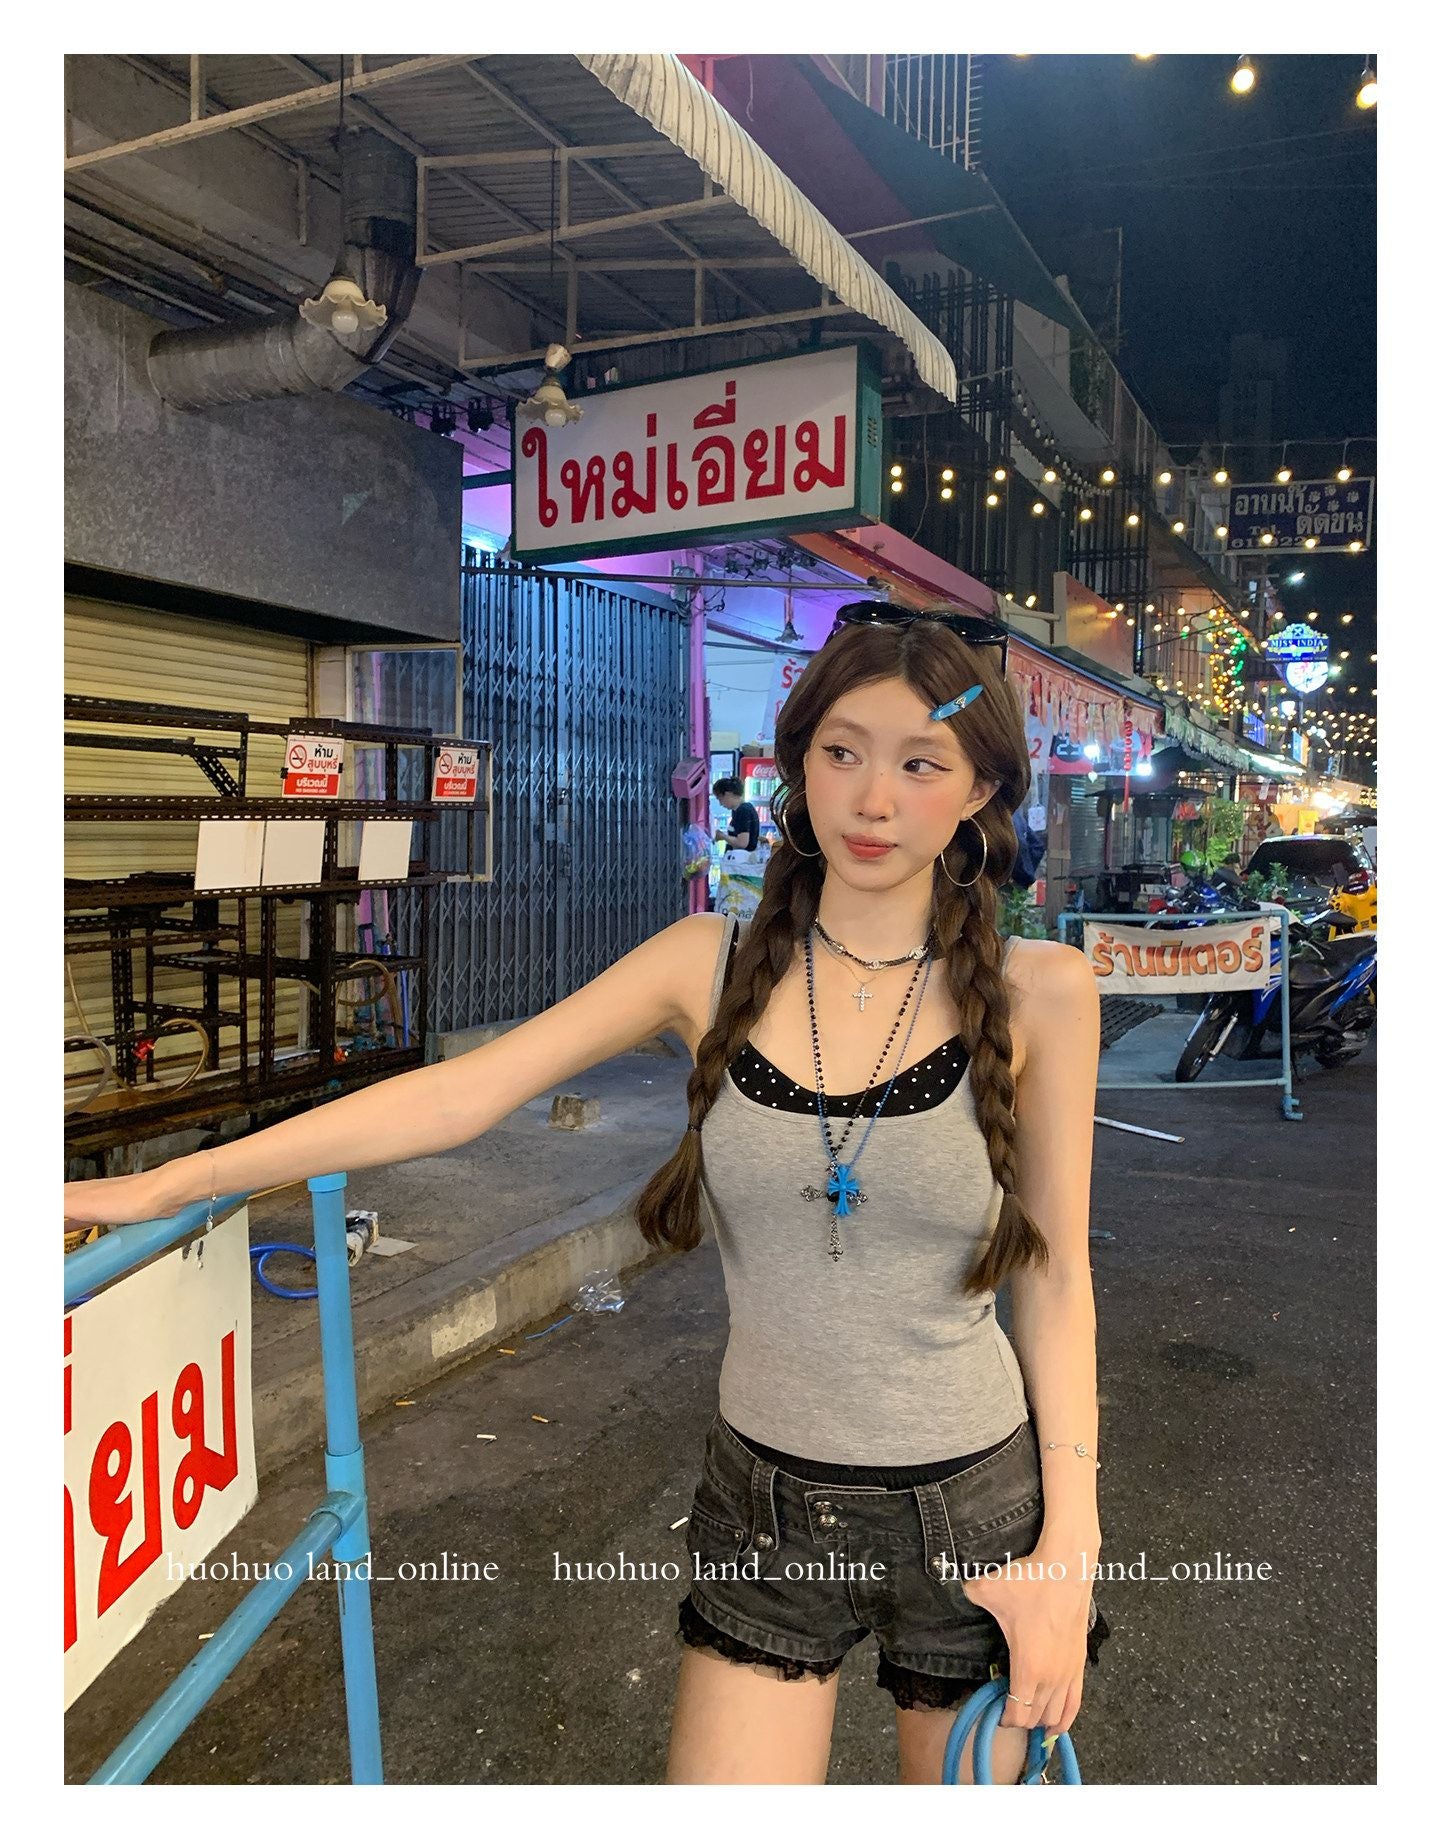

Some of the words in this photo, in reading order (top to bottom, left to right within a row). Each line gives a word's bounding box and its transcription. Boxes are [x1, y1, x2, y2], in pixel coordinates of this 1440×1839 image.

[521, 381, 846, 529] ใหม่เอี่ยม
[1234, 485, 1308, 516] อาบน้ำ
[1271, 640, 1293, 648] MISS
[1297, 640, 1324, 648] INDIA
[314, 744, 334, 758] ห้าม
[307, 754, 339, 773] สูบบุหรี่
